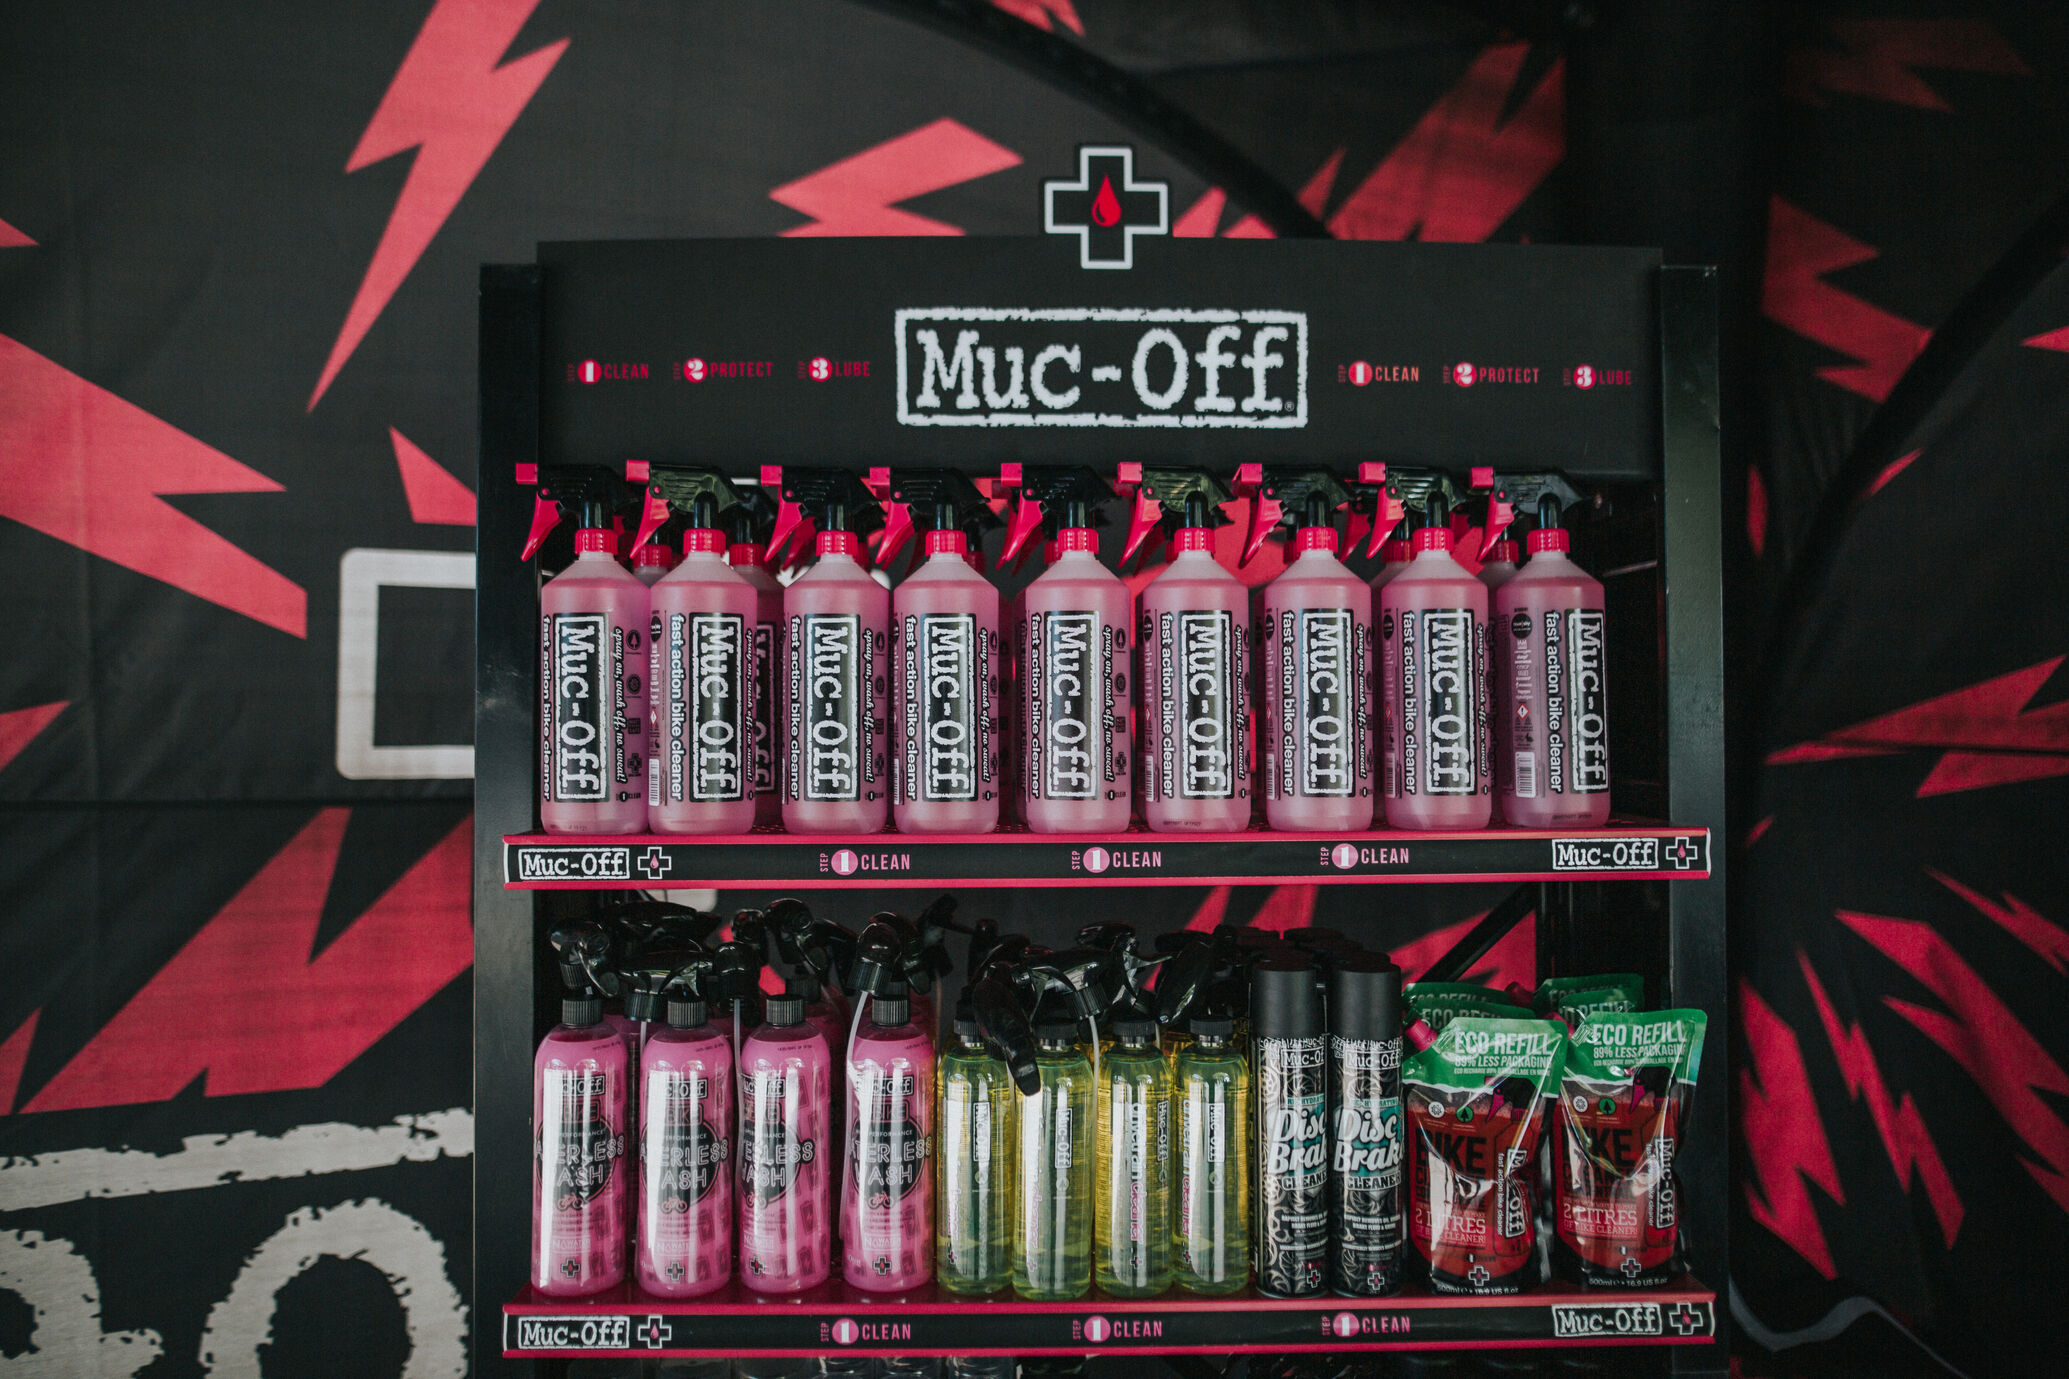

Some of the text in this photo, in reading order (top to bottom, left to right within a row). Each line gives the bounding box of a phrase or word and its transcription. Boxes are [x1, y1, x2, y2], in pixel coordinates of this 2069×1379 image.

[604, 363, 649, 379] CLEAN
[711, 362, 772, 377] PROTECT
[835, 361, 870, 376] LUBE
[916, 325, 1289, 412] Muc-Off
[1375, 366, 1419, 382] CLEAN
[1480, 368, 1539, 383] PROTECT
[1599, 370, 1631, 385] LUBE
[561, 625, 599, 790] Muc-Off
[671, 614, 684, 799] fast action bike cleaner
[700, 625, 736, 789] Muc-Off
[791, 617, 800, 798] fast action bike cleaner
[813, 626, 850, 789] Muc-Off
[906, 617, 917, 799] fast action bike cleaner
[931, 626, 969, 789] Muc-Off
[1032, 614, 1040, 797] fast action bike cleaner
[1052, 623, 1090, 788] Muc-Off
[1162, 614, 1174, 797] fast action bike cleaner
[1189, 623, 1226, 787] Muc-Off
[1283, 612, 1295, 795] fast action bike cleaner
[1310, 621, 1347, 785] Muc-Off
[1403, 612, 1416, 793] fast action bike cleaner
[1432, 621, 1469, 783] Muc-Off
[1547, 613, 1563, 791] fast action bike cleaner
[1578, 622, 1605, 780] Muc-Off
[524, 852, 625, 876] Muc-Off
[820, 852, 910, 872] STEP 1 CLEAN
[1072, 849, 1161, 870] STEP 1 CLEAN
[1321, 845, 1409, 867] STEP 1 CLEAN
[1558, 842, 1654, 866] Muc-Off
[1455, 1032, 1550, 1055] ECO REFILL
[1593, 1020, 1687, 1046] ECO REFILL
[1478, 1056, 1499, 1067] LESS
[1594, 1047, 1613, 1058] 89%
[1615, 1047, 1637, 1058] LESS
[1338, 1109, 1398, 1142] Disc
[523, 1321, 625, 1345] Muc-Off
[841, 1321, 850, 1343] 1
[862, 1324, 911, 1340] CLEAN
[1092, 1319, 1102, 1341] 1
[1113, 1321, 1162, 1338] CLEAN
[1341, 1315, 1350, 1336] 1
[1362, 1316, 1410, 1333] CLEAN
[1558, 1307, 1656, 1333] Muc-Off
